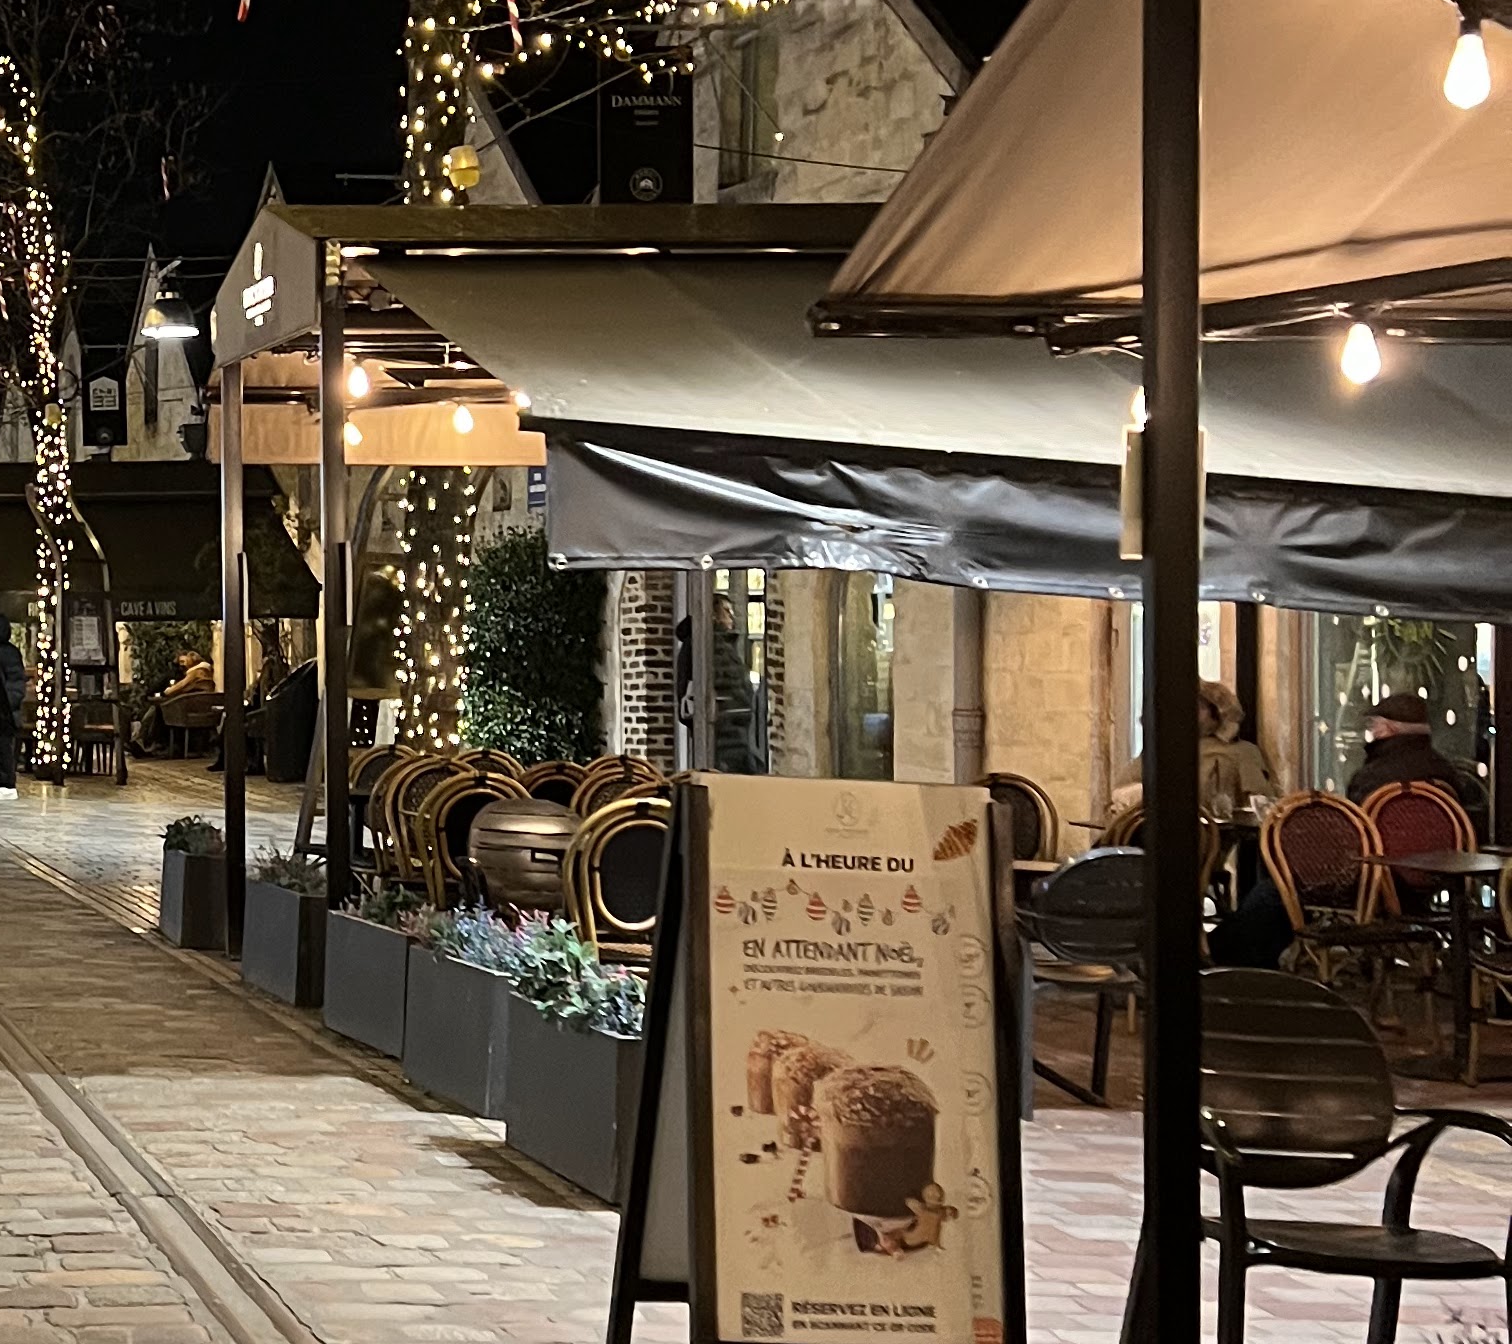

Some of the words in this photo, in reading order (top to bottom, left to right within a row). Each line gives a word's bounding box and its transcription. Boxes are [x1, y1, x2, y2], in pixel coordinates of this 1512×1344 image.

[611, 94, 682, 108] DAMMANN
[120, 601, 144, 616] CAVE
[154, 601, 177, 616] VINS
[782, 847, 795, 867] À
[801, 852, 882, 872] L'HEURE
[887, 856, 914, 873] DU
[743, 938, 765, 958] EN
[772, 939, 874, 963] ATTENDANT
[870, 1303, 890, 1317] EN
